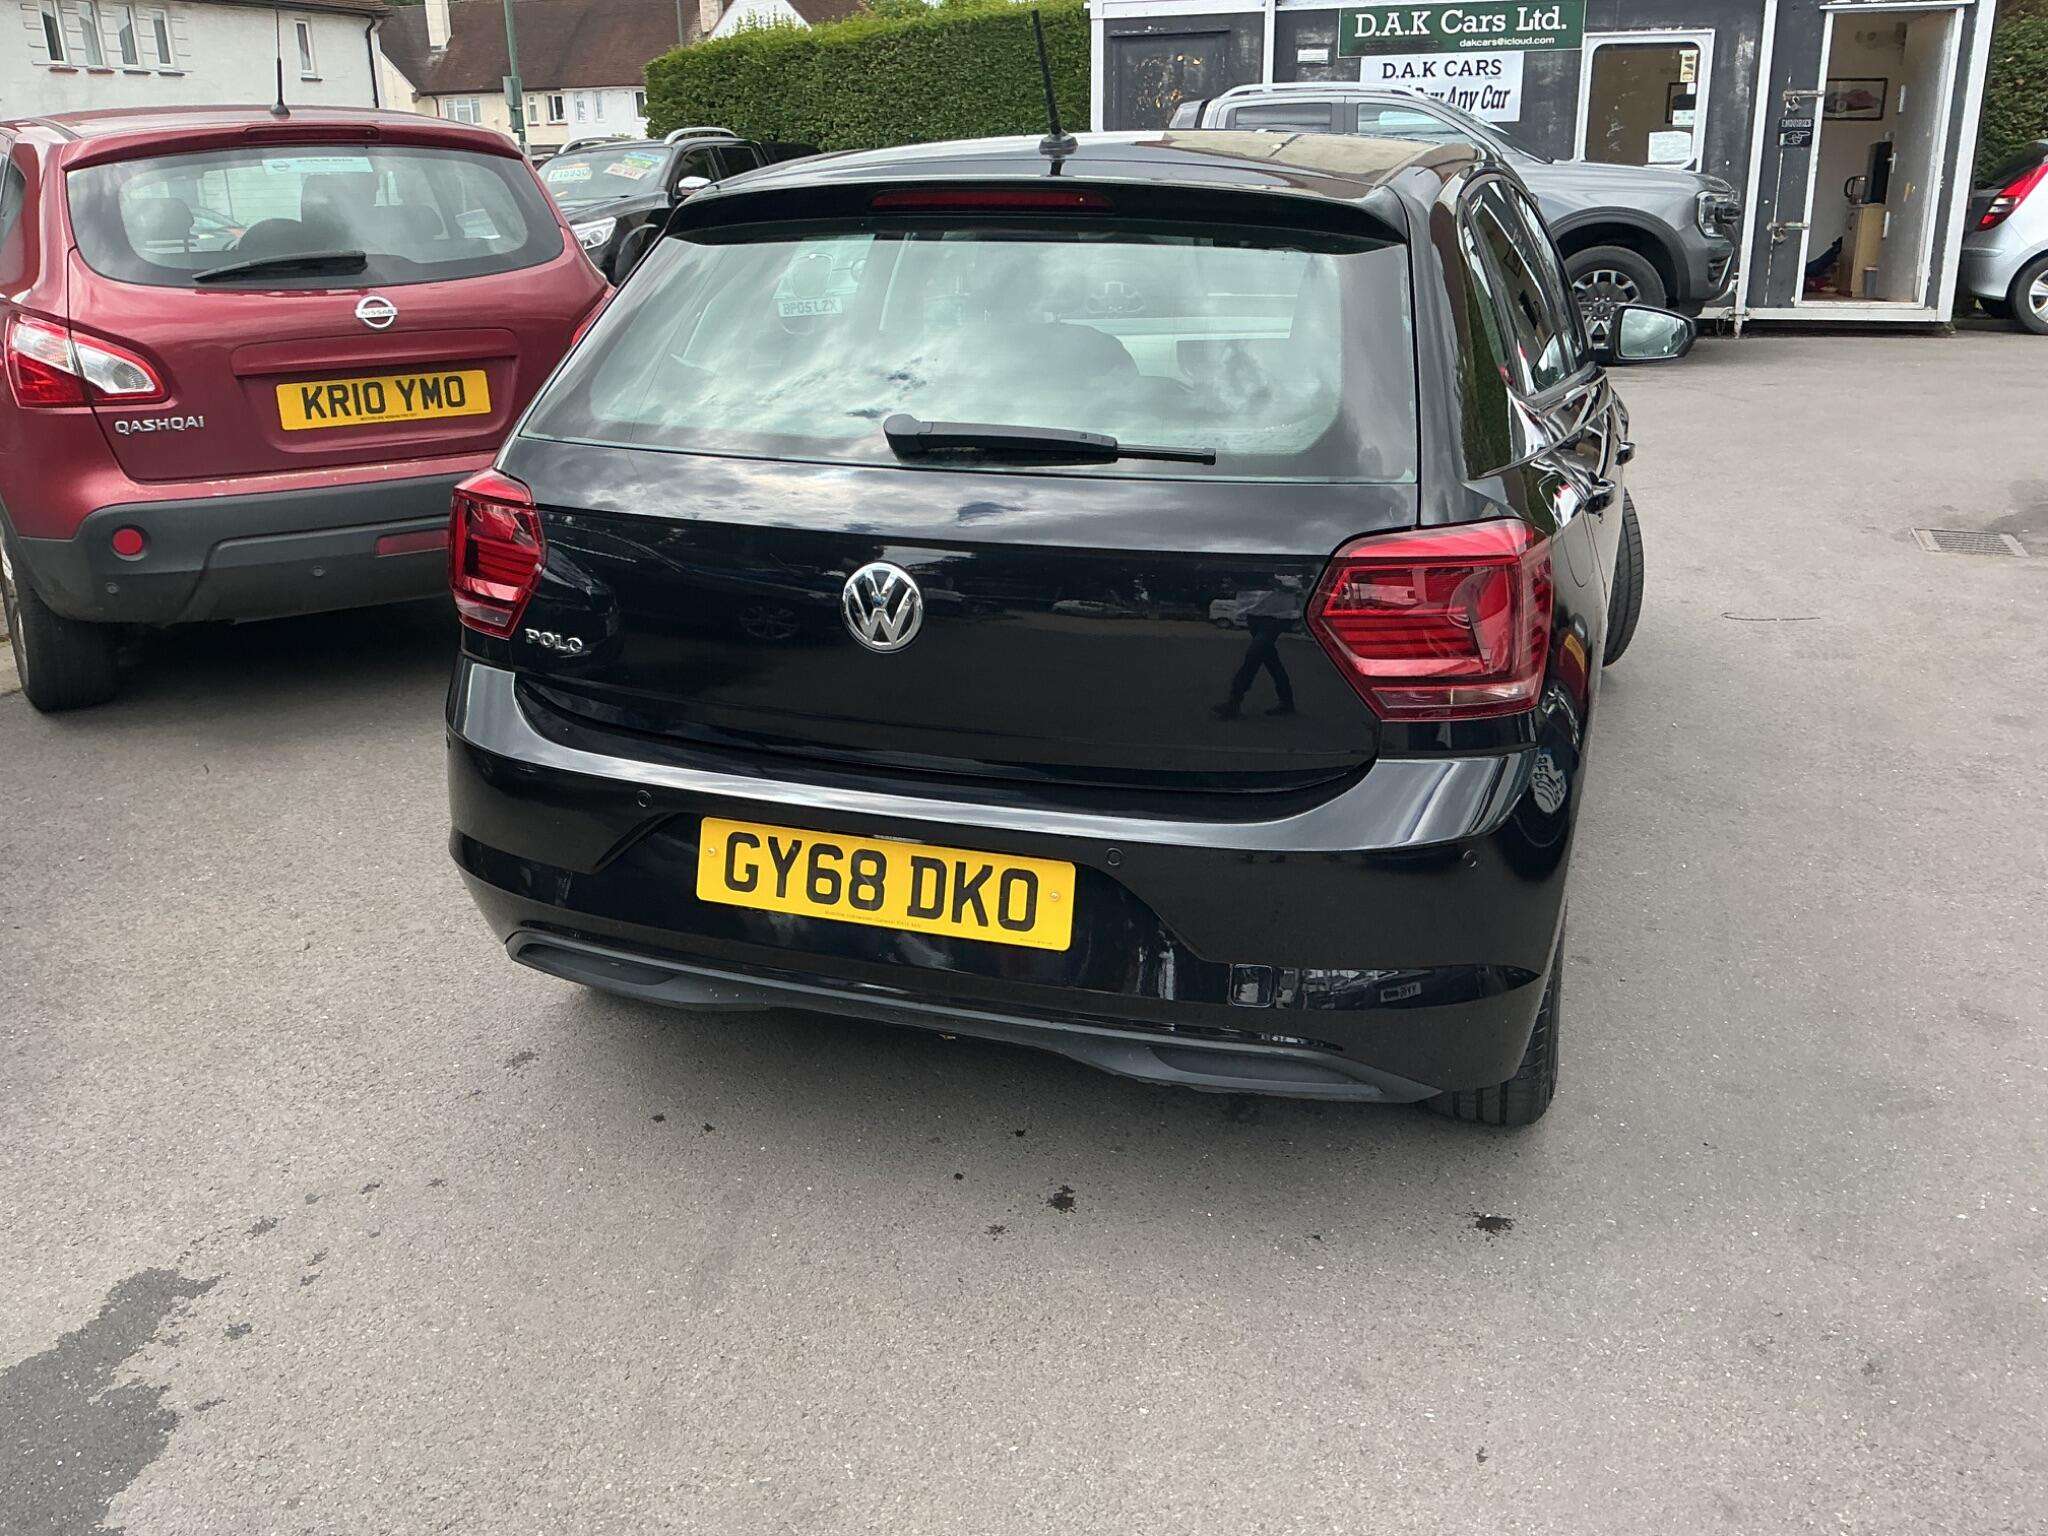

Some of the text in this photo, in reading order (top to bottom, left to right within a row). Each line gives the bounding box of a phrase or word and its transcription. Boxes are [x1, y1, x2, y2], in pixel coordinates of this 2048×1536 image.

[1354, 6, 1567, 37] D.A.K Cars Ltd.
[1459, 37, 1555, 47] dakcars@icloud.com
[1382, 59, 1502, 79] D.A.K CARS
[1448, 86, 1479, 112] Any
[1481, 85, 1511, 109] Car
[302, 374, 467, 420] KR10 YMO
[115, 416, 204, 434] QASHQAI
[524, 628, 583, 652] POLO
[724, 831, 1040, 934] GY68 DKO
